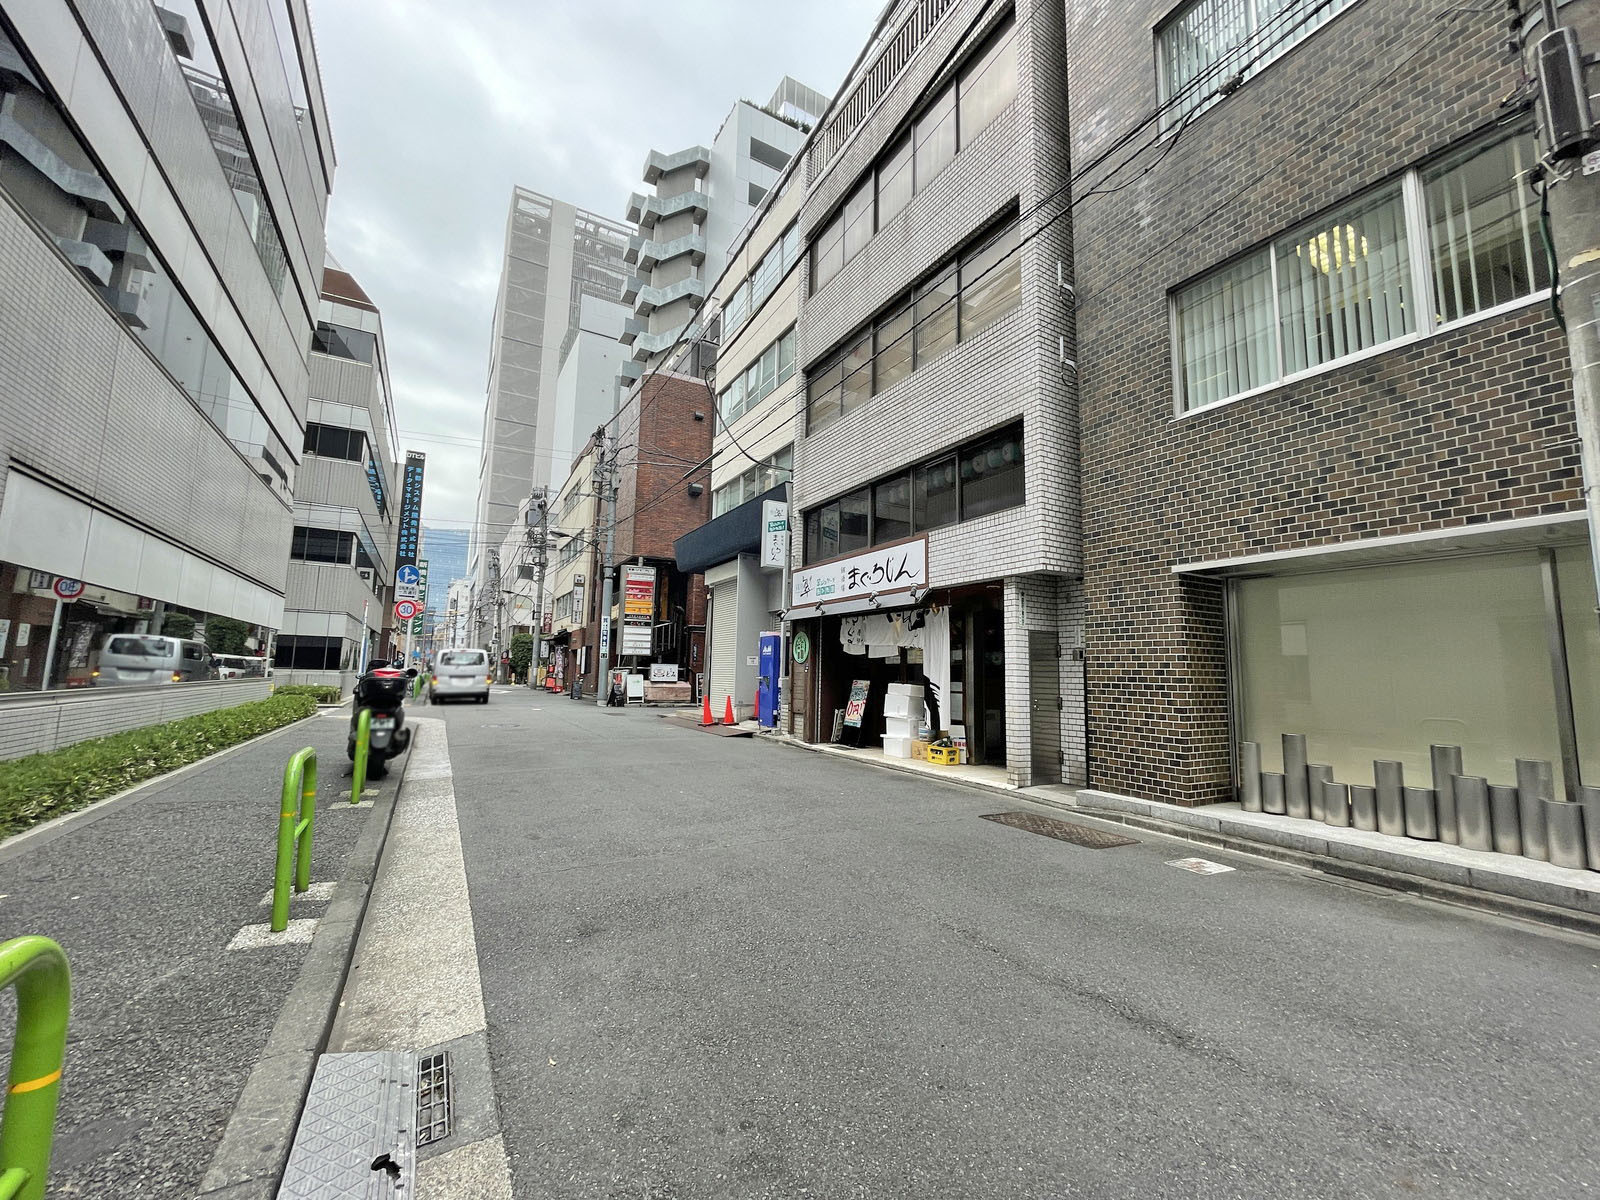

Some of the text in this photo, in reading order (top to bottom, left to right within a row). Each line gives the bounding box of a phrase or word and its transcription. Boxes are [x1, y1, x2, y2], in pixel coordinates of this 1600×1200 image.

[847, 552, 920, 590] まぐろじん
[400, 605, 412, 614] 30
